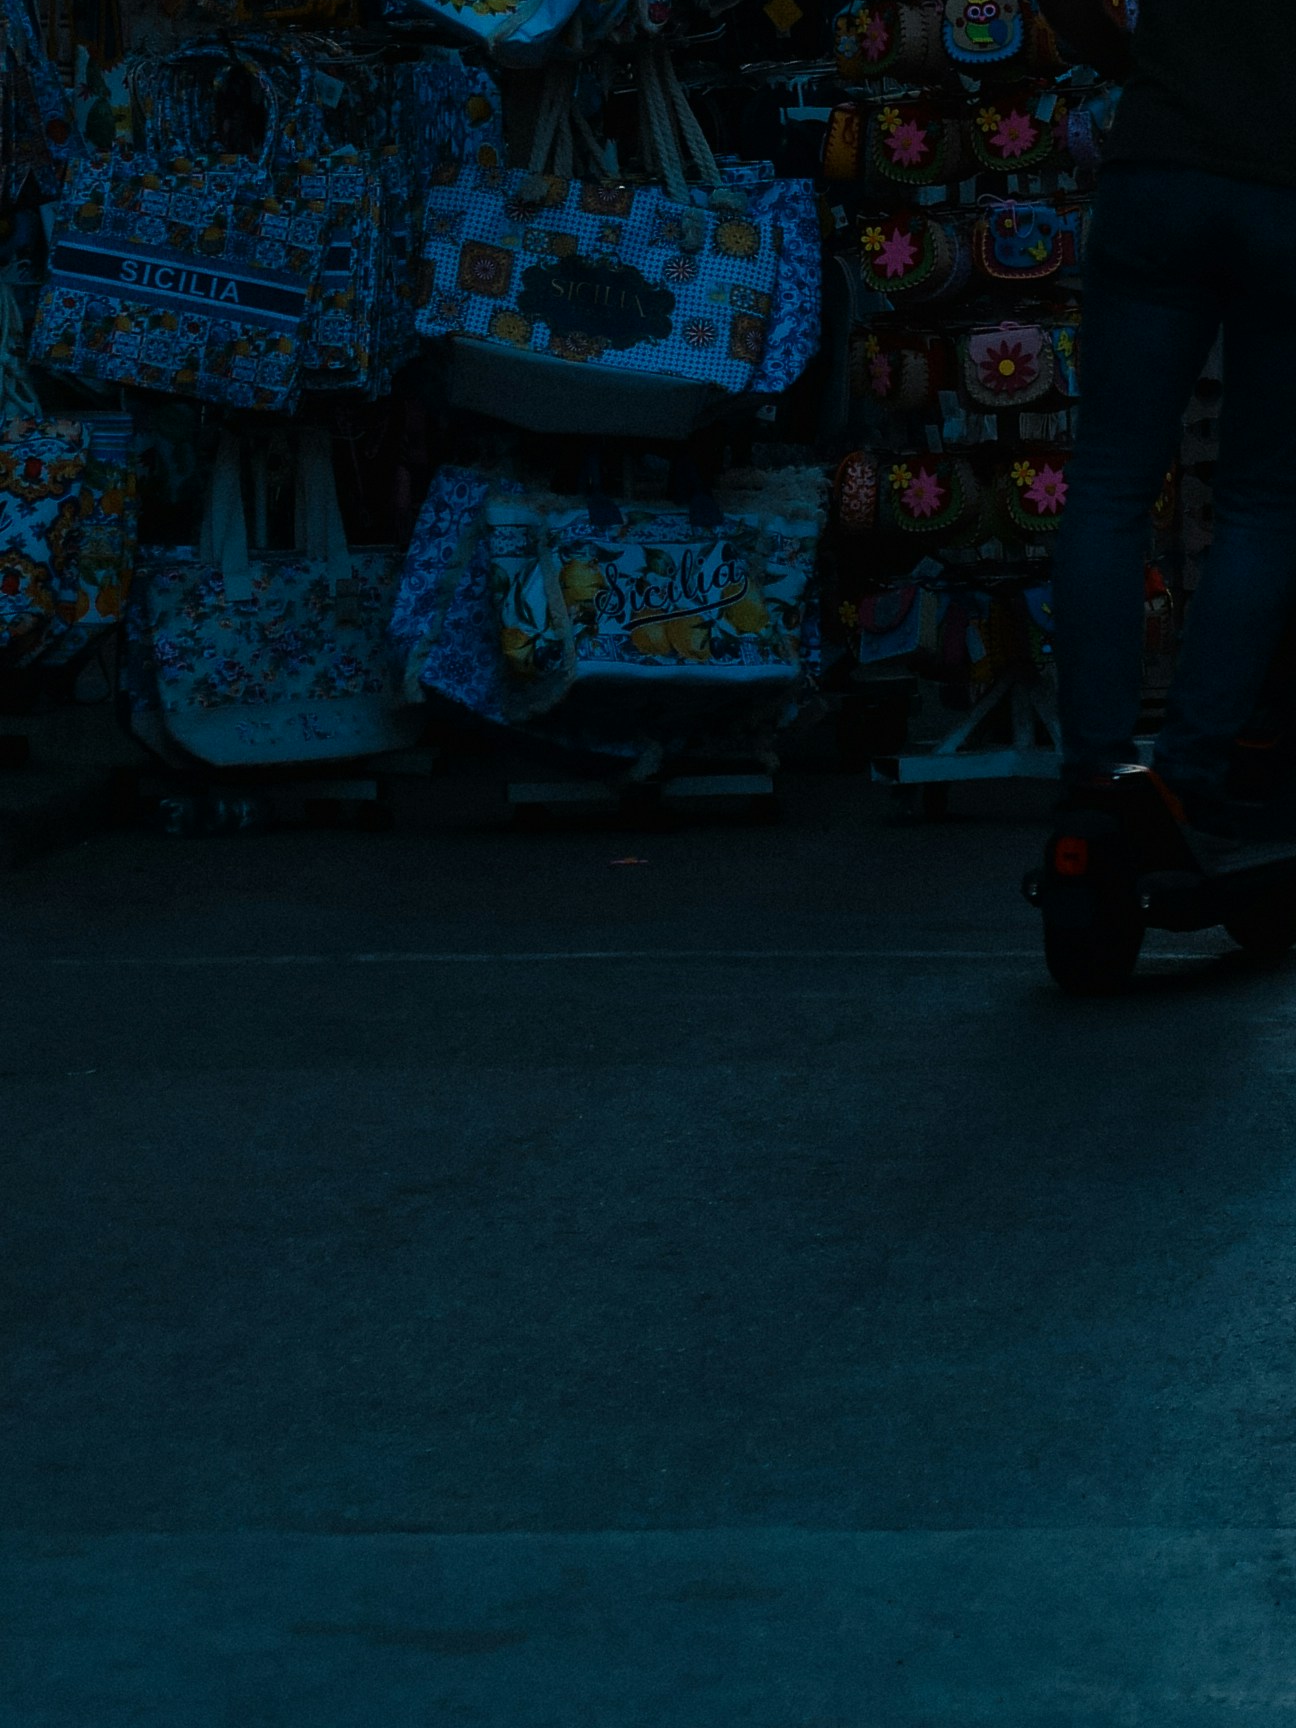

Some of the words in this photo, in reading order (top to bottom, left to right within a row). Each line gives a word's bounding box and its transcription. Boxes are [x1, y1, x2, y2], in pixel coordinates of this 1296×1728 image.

[119, 260, 240, 304] SICILIA
[550, 278, 647, 319] SICILIA
[594, 549, 748, 624] Sicilia
